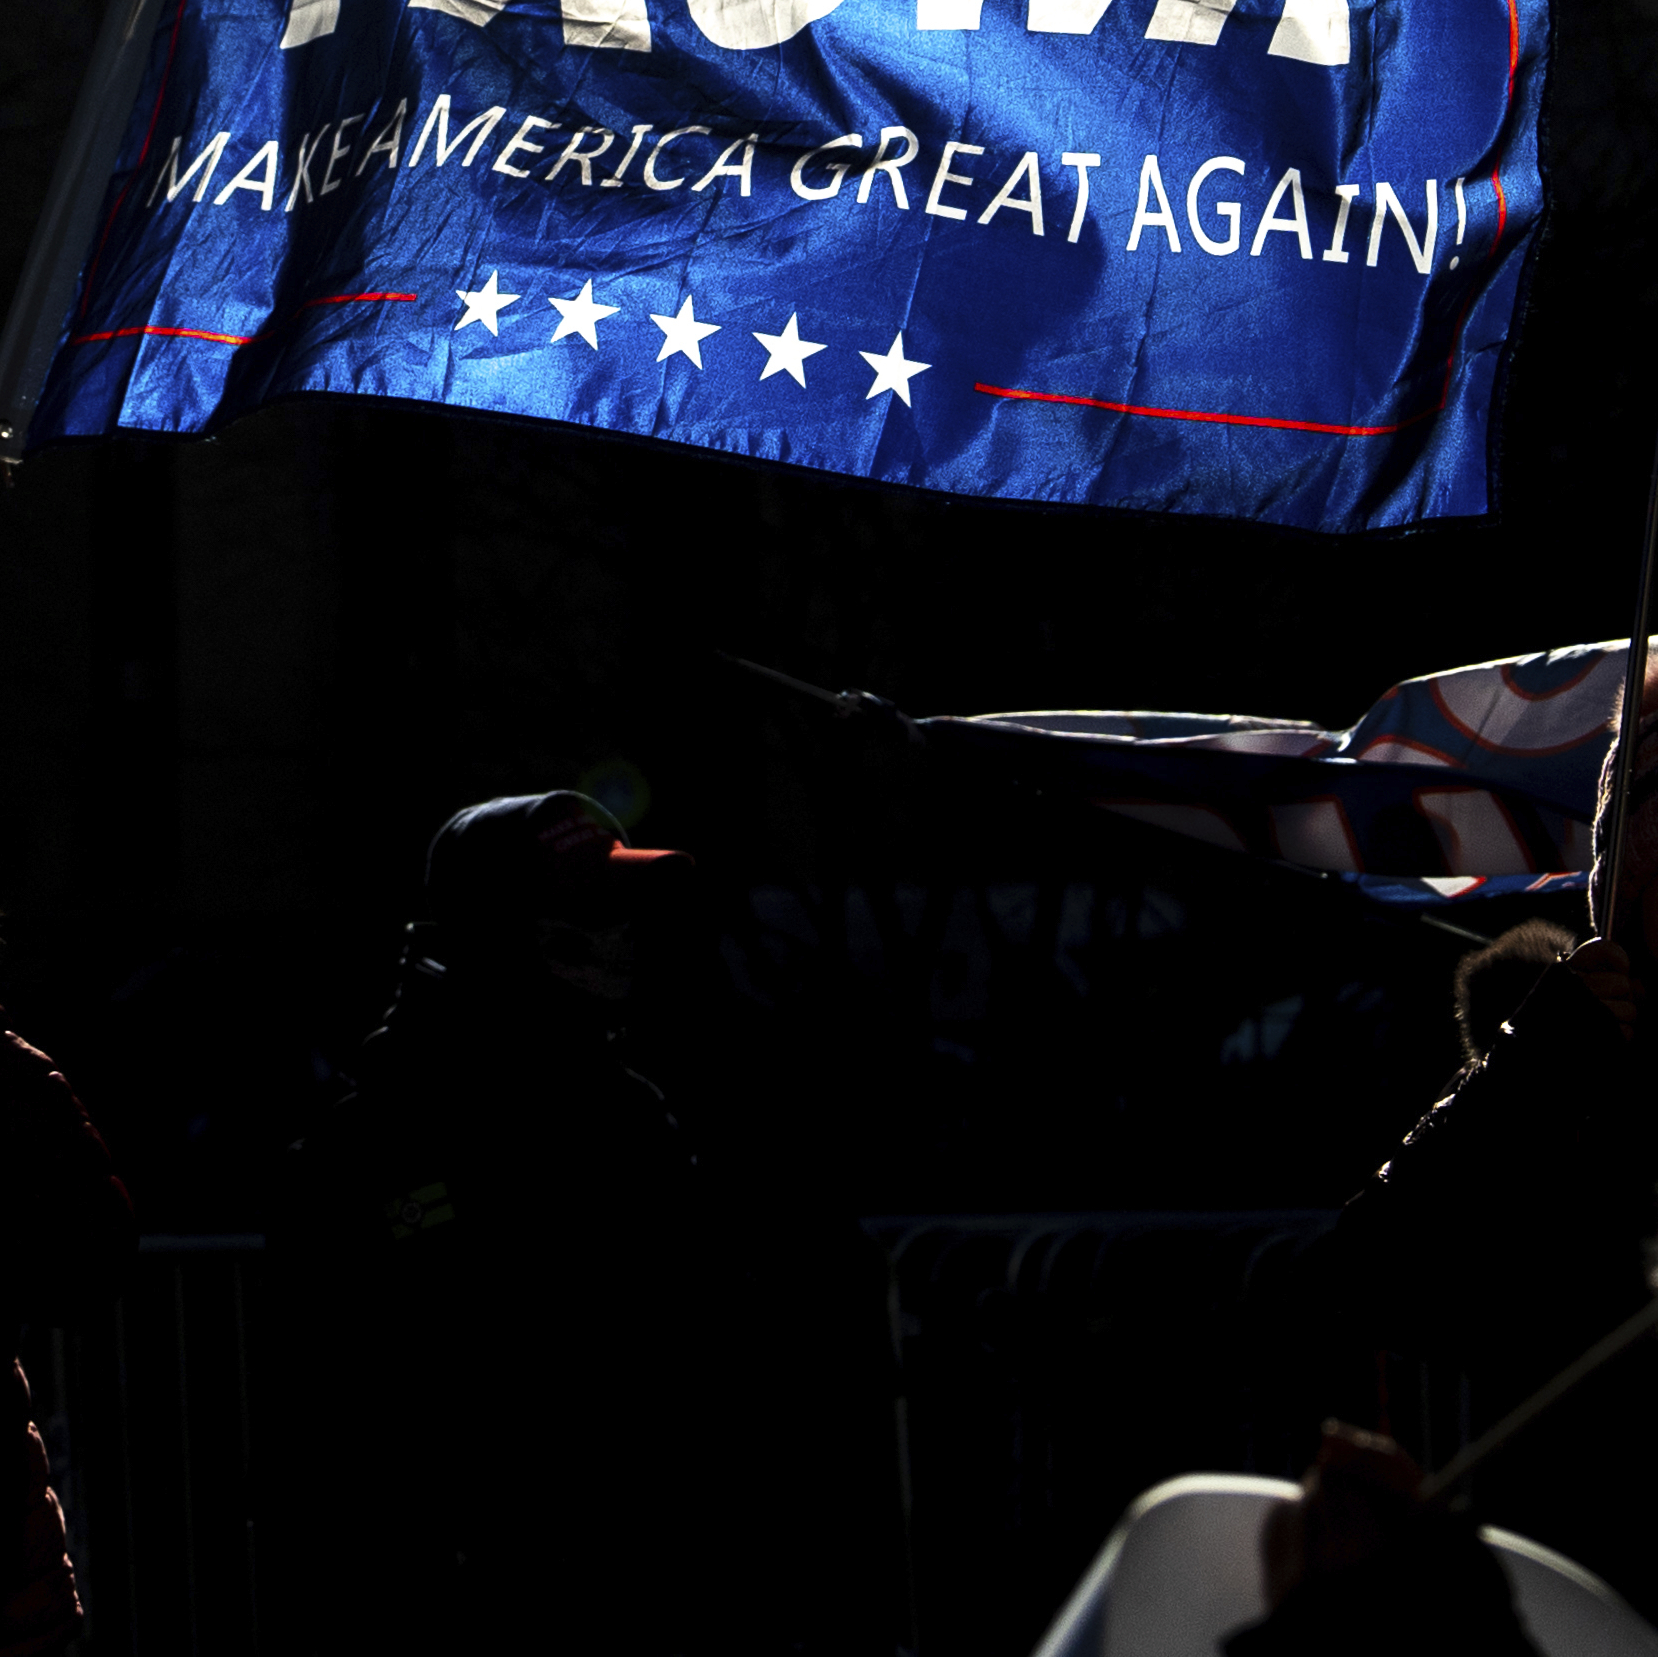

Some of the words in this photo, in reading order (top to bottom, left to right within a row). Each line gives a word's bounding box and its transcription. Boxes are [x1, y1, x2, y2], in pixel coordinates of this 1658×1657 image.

[145, 113, 364, 212] MAKE
[355, 94, 758, 197] AMERICA
[790, 126, 1101, 243] GREAT
[1125, 154, 1467, 275] AGAIN!
